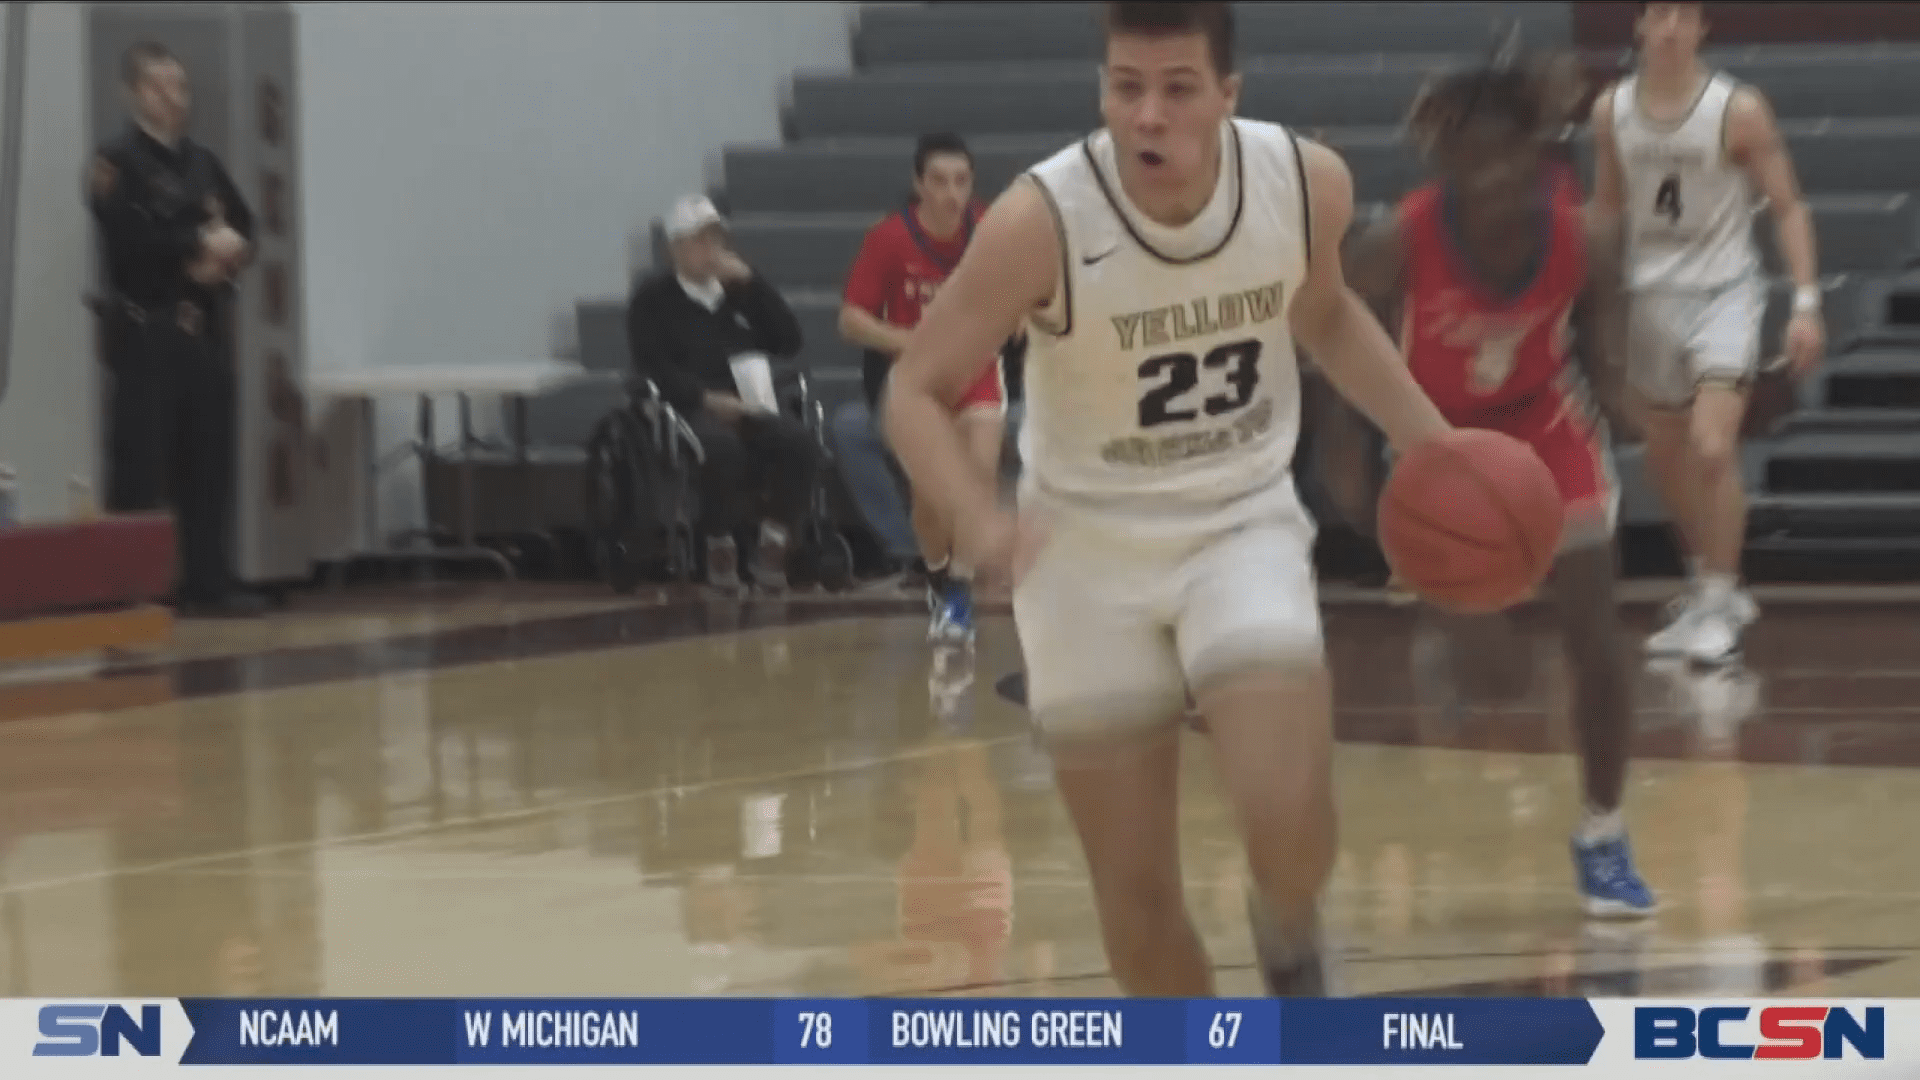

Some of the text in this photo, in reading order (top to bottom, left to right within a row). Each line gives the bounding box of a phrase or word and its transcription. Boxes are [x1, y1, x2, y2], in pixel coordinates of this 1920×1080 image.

[1653, 173, 1684, 226] 4
[1110, 281, 1284, 350] YELLOW
[1137, 338, 1262, 428] 23
